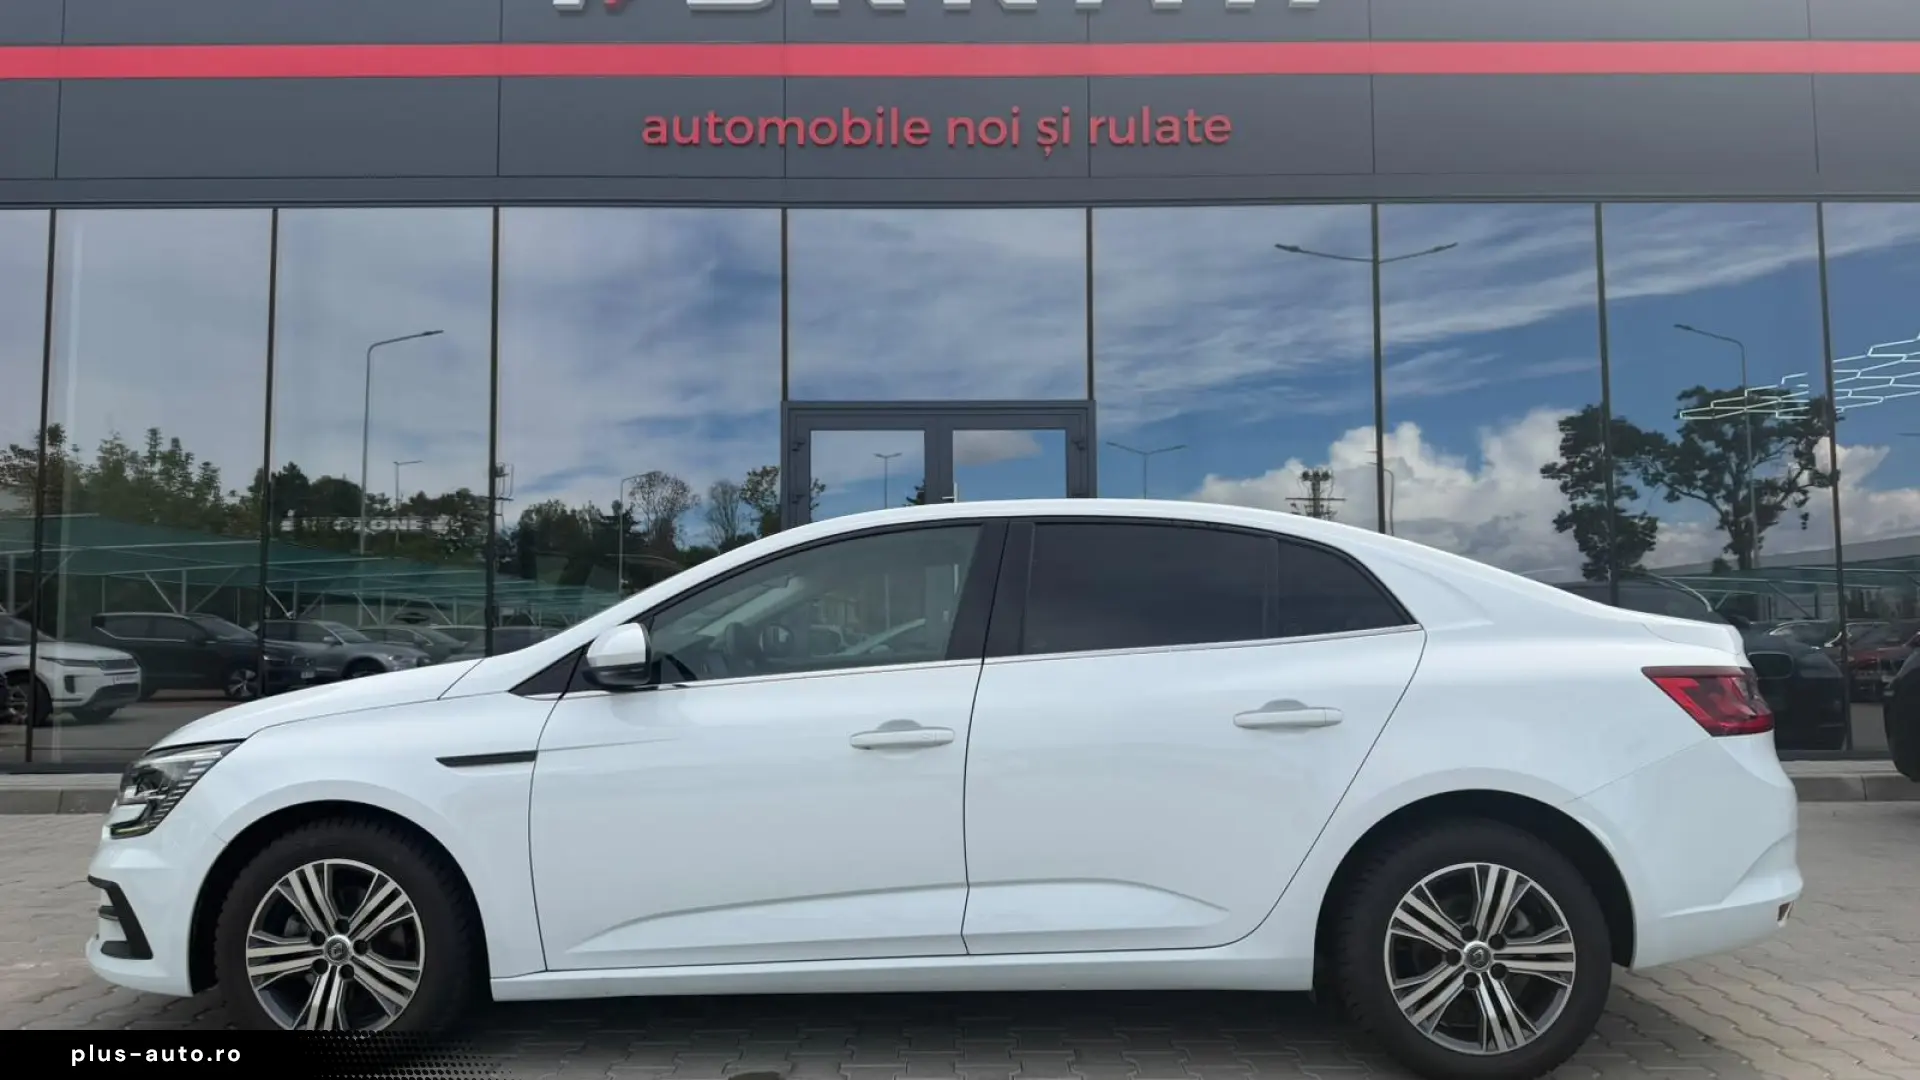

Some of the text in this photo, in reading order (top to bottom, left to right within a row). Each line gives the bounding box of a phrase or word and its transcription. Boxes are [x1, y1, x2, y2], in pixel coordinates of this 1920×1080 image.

[642, 105, 1232, 157] automobile noi și rulate
